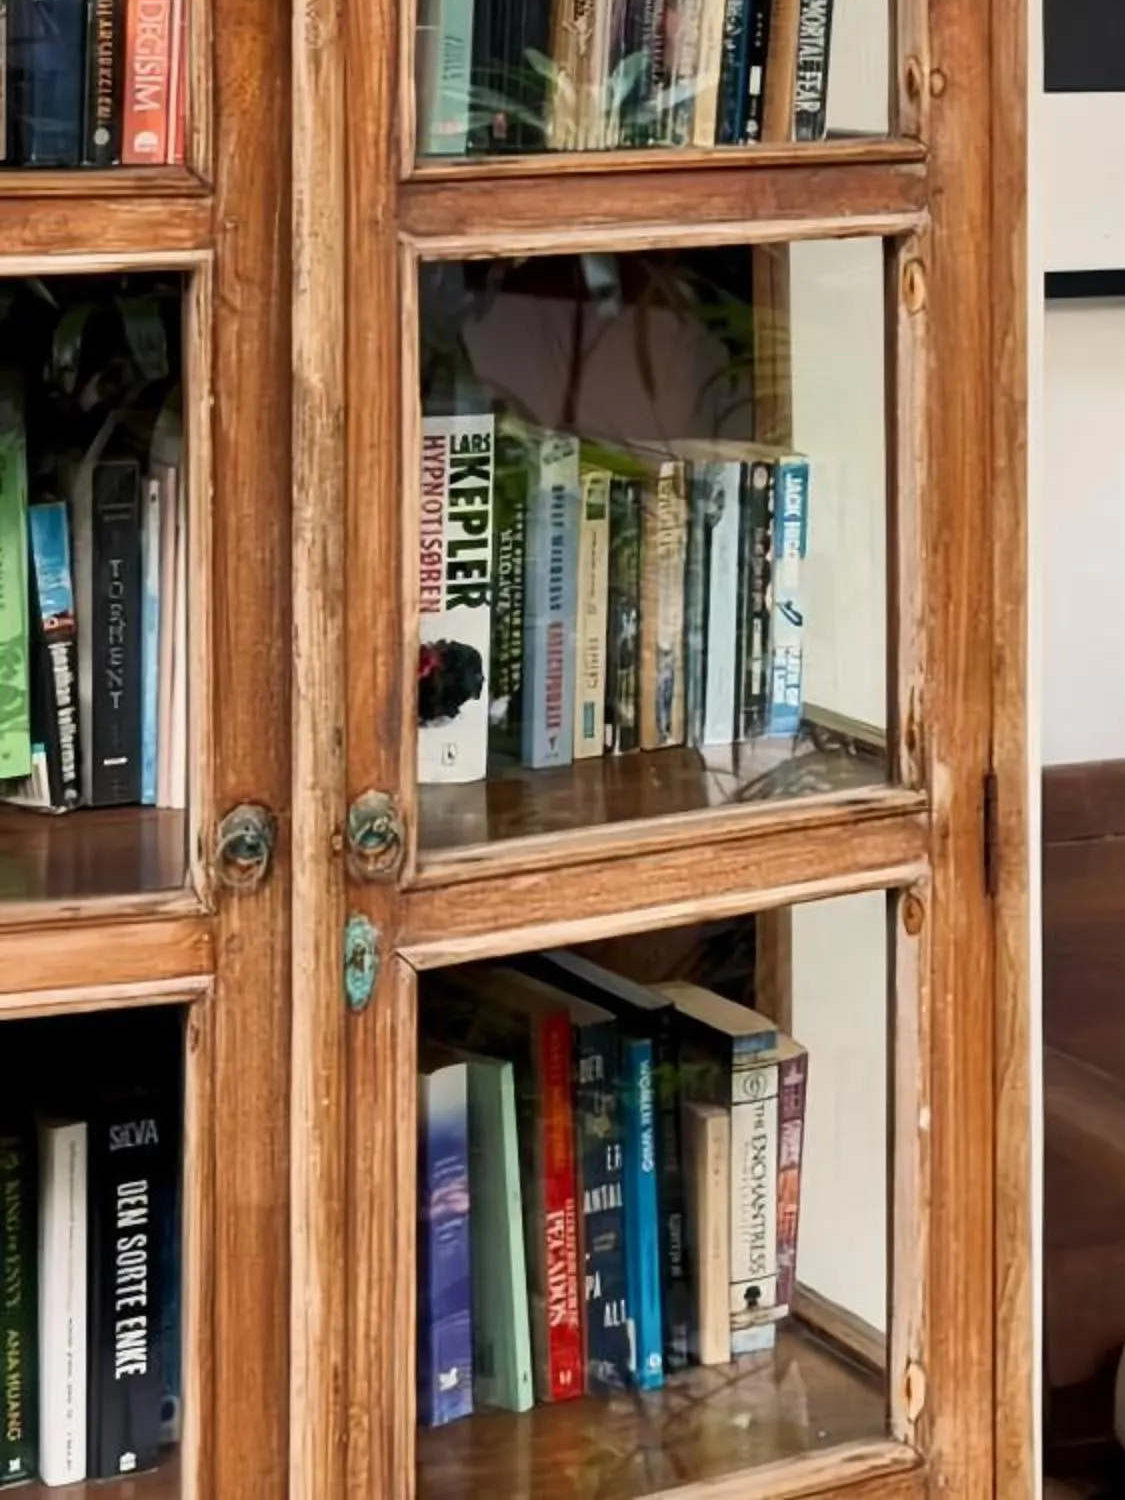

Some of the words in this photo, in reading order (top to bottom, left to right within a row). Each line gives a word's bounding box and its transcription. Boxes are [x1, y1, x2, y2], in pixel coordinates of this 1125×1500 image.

[795, 71, 823, 113] FEAR
[450, 433, 491, 454] LARS
[418, 434, 446, 614] HYPNOTISØREN
[784, 473, 802, 516] JACK
[445, 455, 492, 610] KEPLER
[106, 558, 126, 710] TORMENT
[109, 1118, 160, 1153] SILVA
[753, 1103, 765, 1132] THE
[640, 1128, 655, 1173] WHO
[116, 1178, 149, 1229] DEN
[749, 1133, 769, 1276] ENCHANTRESS
[115, 1233, 148, 1312] SORTE
[545, 1208, 566, 1328] PECADOS
[5, 1329, 21, 1371] ANA
[115, 1314, 148, 1381] ENKE
[5, 1374, 22, 1442] HUANG
